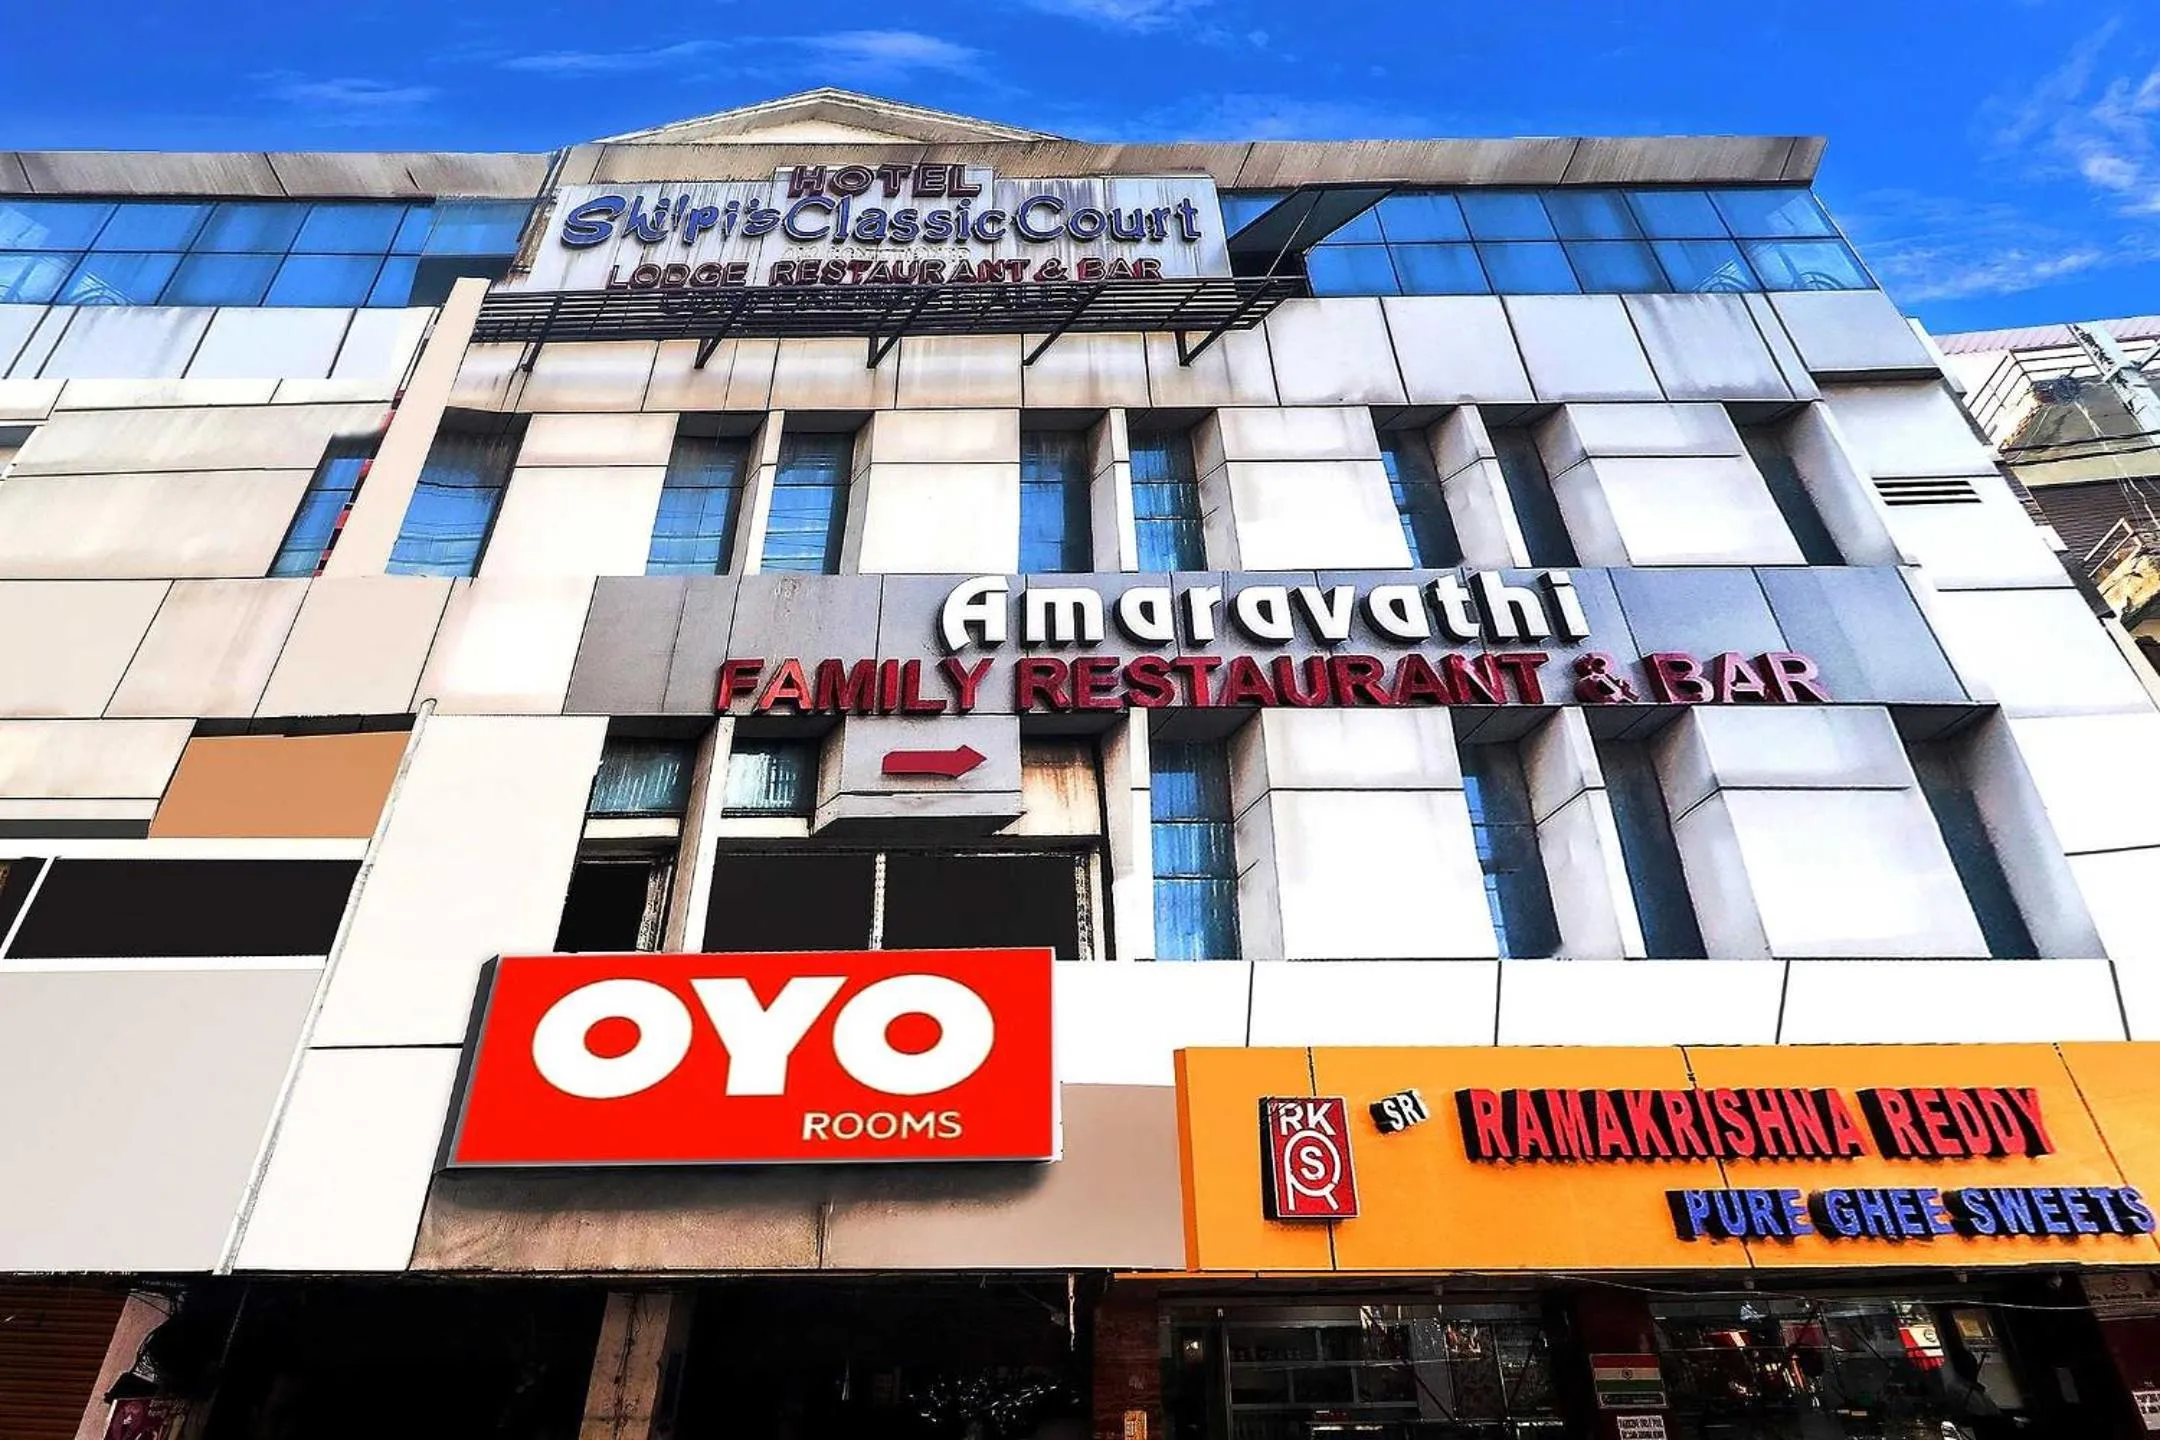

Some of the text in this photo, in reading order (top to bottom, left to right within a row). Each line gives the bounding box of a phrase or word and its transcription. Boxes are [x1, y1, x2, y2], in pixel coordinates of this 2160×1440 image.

[788, 163, 983, 198] HOTEL
[784, 195, 1006, 243] Classic
[1016, 195, 1201, 243] Court
[606, 257, 1163, 289] LODGE RESTAURANT & BAR
[939, 571, 1589, 652] Amaravathi
[716, 651, 1834, 714] FAMILY RESTAURANT & BAR
[532, 973, 995, 1099] OYO
[802, 1110, 963, 1141] ROOMS
[1279, 1102, 1336, 1135] RK
[1378, 1088, 2056, 1162] SRI RAMAKRISHNA REDDY
[1669, 1186, 2157, 1241] PURE GHEE SWEETS
